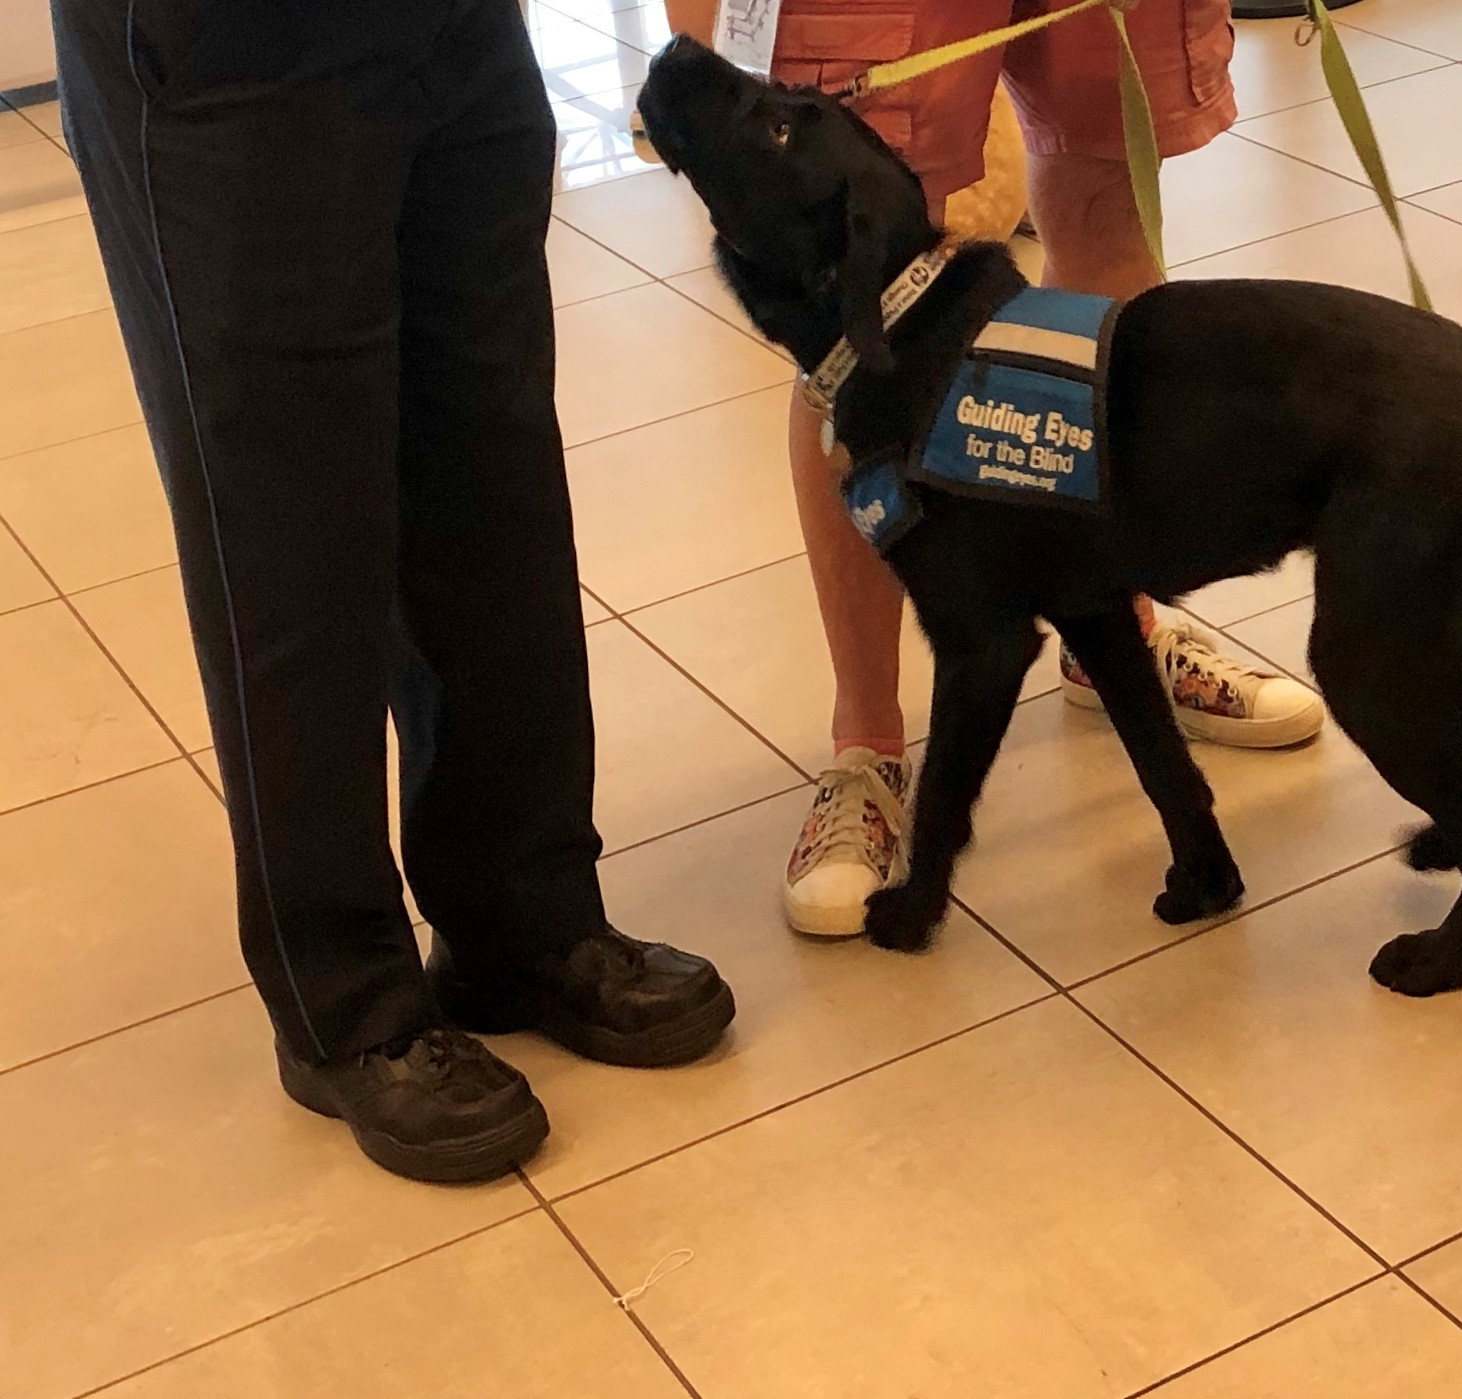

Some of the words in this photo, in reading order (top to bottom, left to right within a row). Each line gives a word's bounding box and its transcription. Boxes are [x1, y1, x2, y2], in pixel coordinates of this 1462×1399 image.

[957, 395, 1042, 444] Guiding
[1043, 411, 1095, 452] Eyes
[966, 433, 993, 459] for
[996, 439, 1026, 465] the
[1029, 445, 1075, 475] Blind
